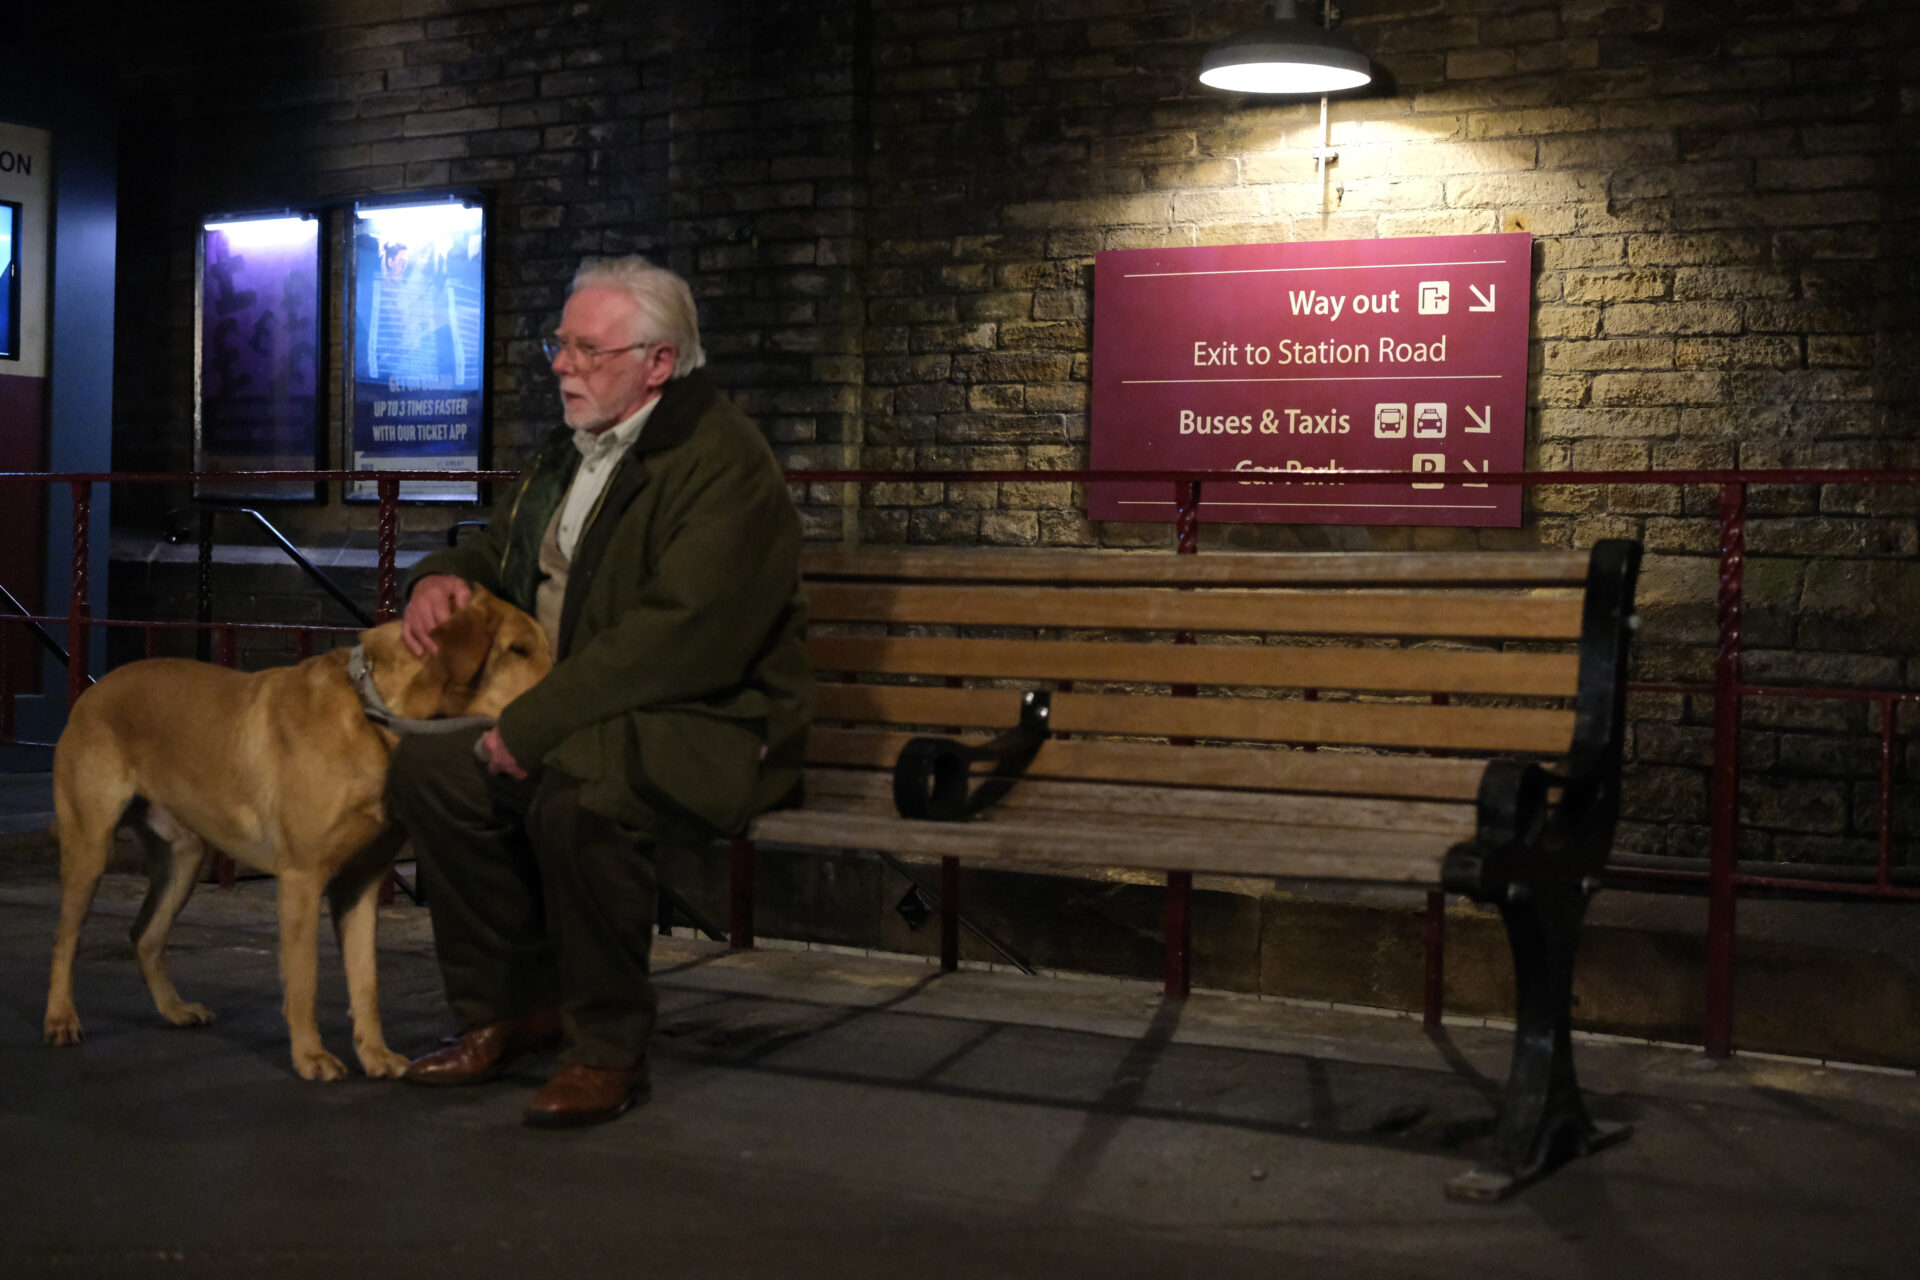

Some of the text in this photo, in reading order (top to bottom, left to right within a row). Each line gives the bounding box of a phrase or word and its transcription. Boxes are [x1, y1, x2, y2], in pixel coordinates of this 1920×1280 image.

[1289, 290, 1400, 321] Way out
[1194, 335, 1447, 366] Exit to Station Road
[374, 398, 468, 418] UP TO 3 TIMES FASTER
[1179, 408, 1350, 435] Buses & Taxis
[373, 424, 468, 442] WITH OUR TICKET APP
